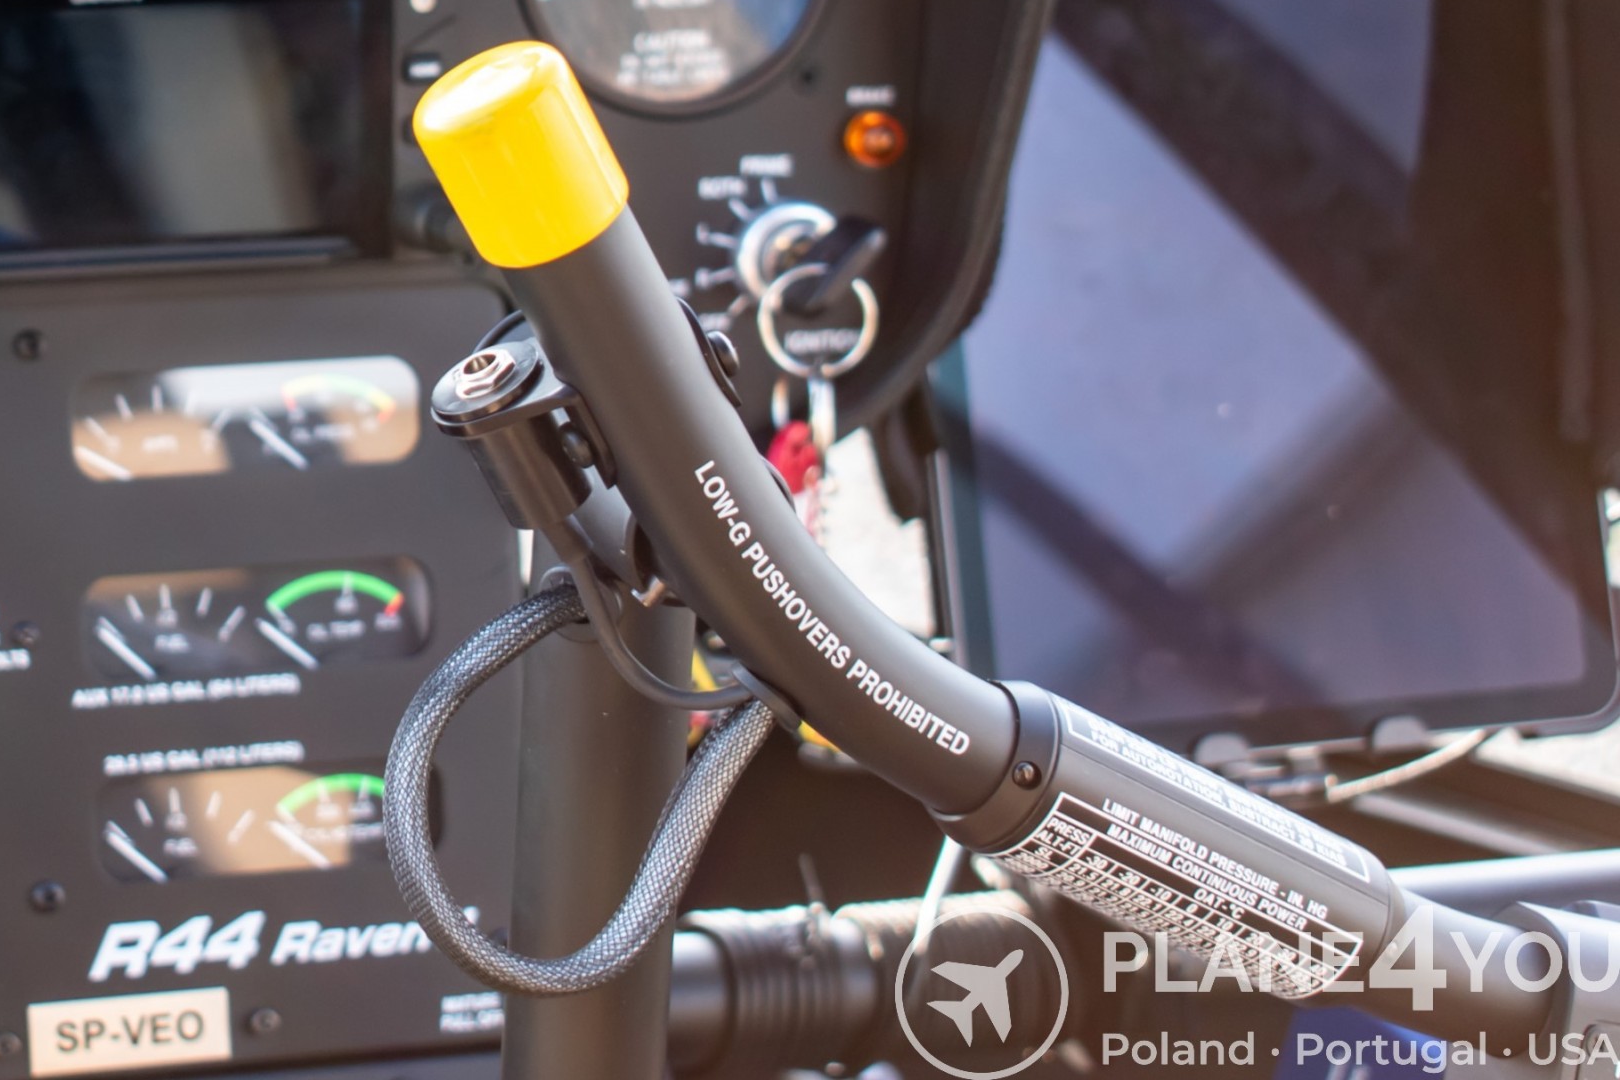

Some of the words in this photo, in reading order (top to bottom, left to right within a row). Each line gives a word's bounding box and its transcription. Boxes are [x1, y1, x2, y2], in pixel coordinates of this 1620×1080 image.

[693, 460, 753, 548] LOW-G
[741, 540, 852, 670] PUSHOVERS
[845, 658, 971, 756] PROHIBITED
[1035, 829, 1082, 858] ALT-FT
[1047, 817, 1091, 846] PRESS
[1102, 798, 1140, 826] LIMIT
[1139, 816, 1208, 862] MANIFOLD
[1208, 850, 1280, 896] PRESSURE
[1306, 898, 1329, 921] HG
[1106, 823, 1173, 867] MAXIMUM
[1172, 857, 1258, 907] CONTINUOUS
[1257, 897, 1309, 931] POWER
[87, 910, 267, 982] R44
[269, 920, 433, 965] Raven
[1217, 918, 1235, 932] 10
[57, 1009, 205, 1054] SP-VEO
